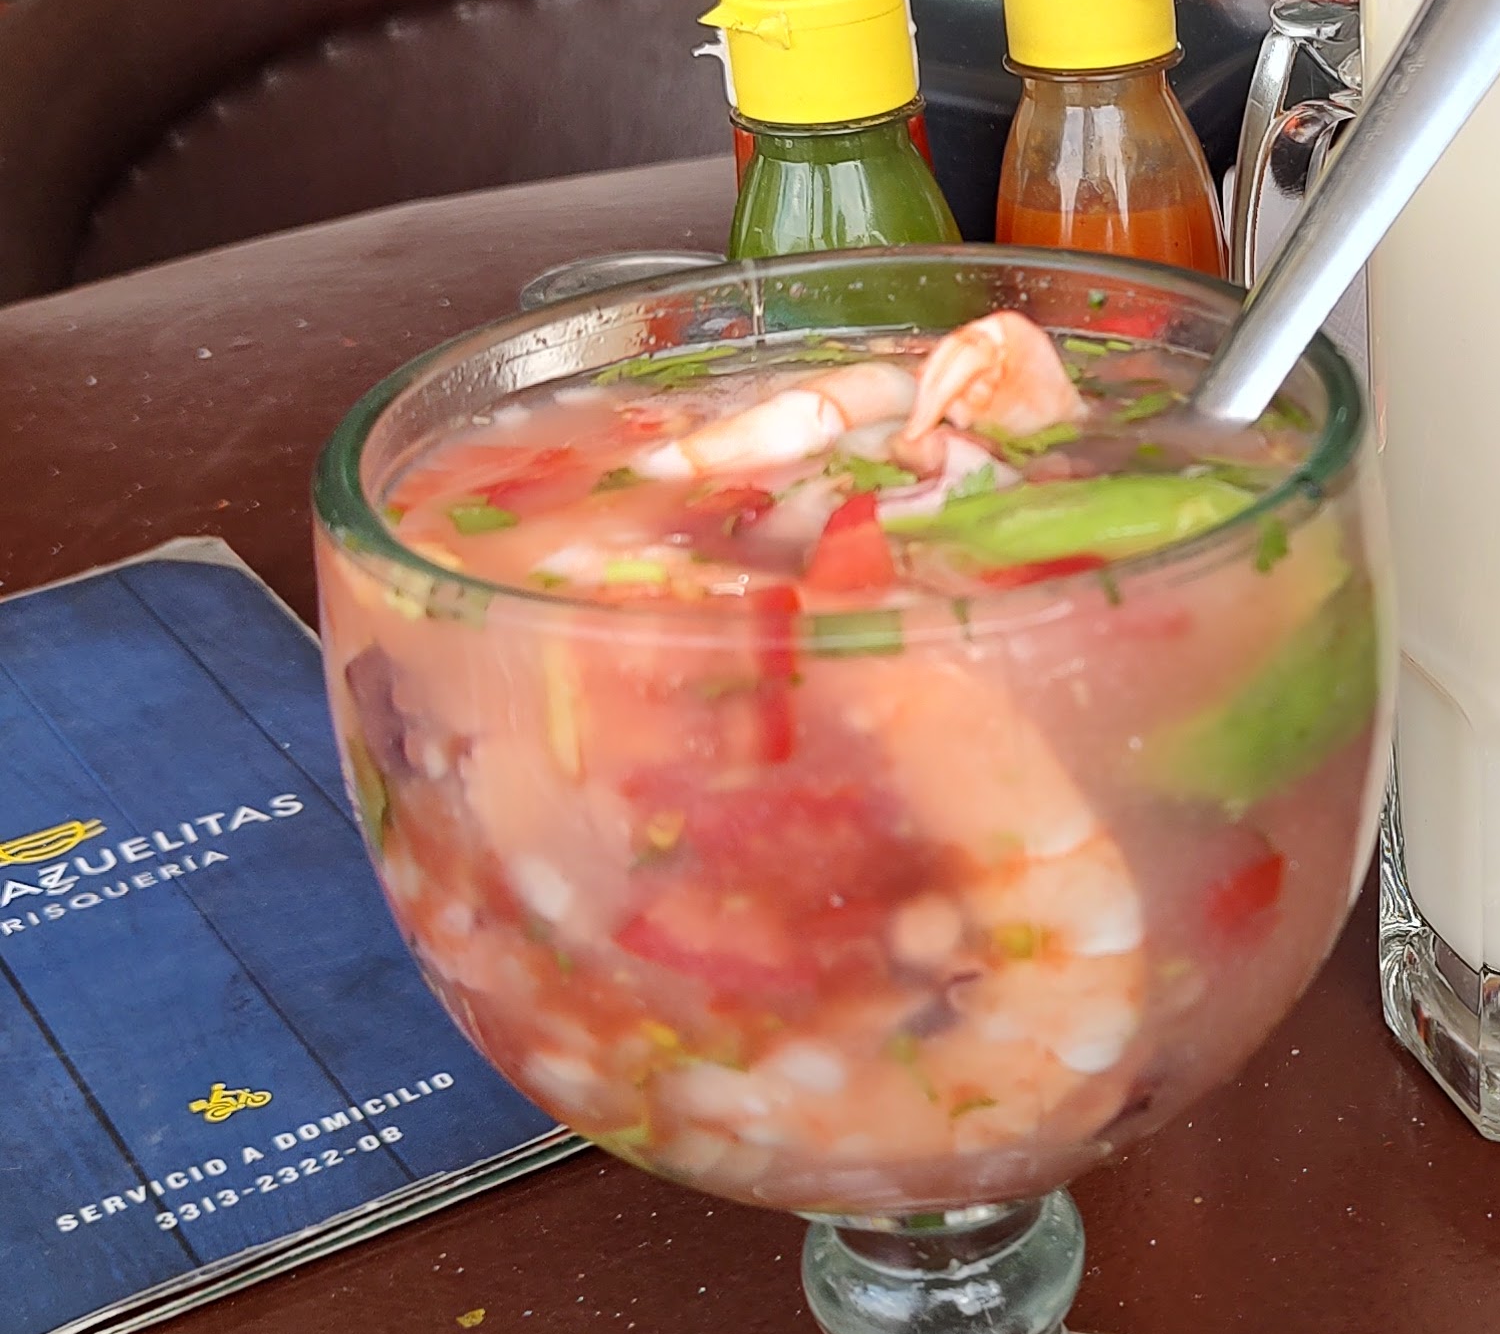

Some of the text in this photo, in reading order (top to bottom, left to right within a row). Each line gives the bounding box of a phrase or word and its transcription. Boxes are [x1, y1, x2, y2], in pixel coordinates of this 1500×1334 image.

[56, 1071, 456, 1233] SERVICIO A DOMICILIO
[154, 1125, 404, 1231] 3313-2322-08
